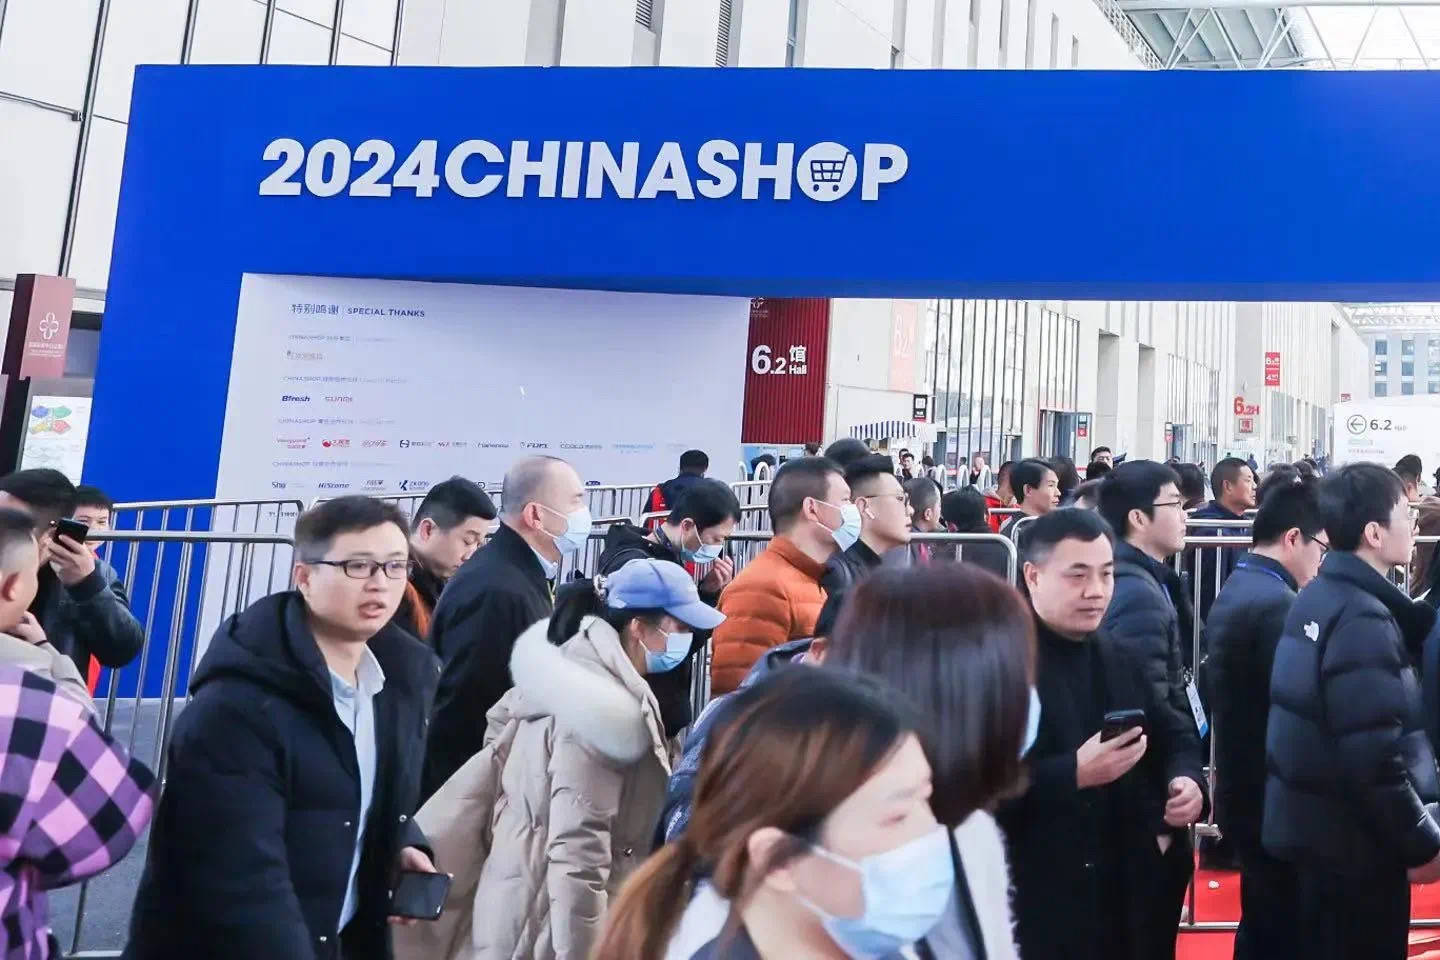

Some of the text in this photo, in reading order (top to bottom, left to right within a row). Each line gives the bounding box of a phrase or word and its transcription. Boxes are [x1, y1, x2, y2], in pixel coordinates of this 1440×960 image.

[292, 303, 339, 315] 特别鸣谢
[347, 307, 425, 318] SPECIAL THANKS
[752, 344, 807, 375] 6.2 馆
[789, 365, 807, 375] Hall
[1370, 419, 1392, 431] 6.2
